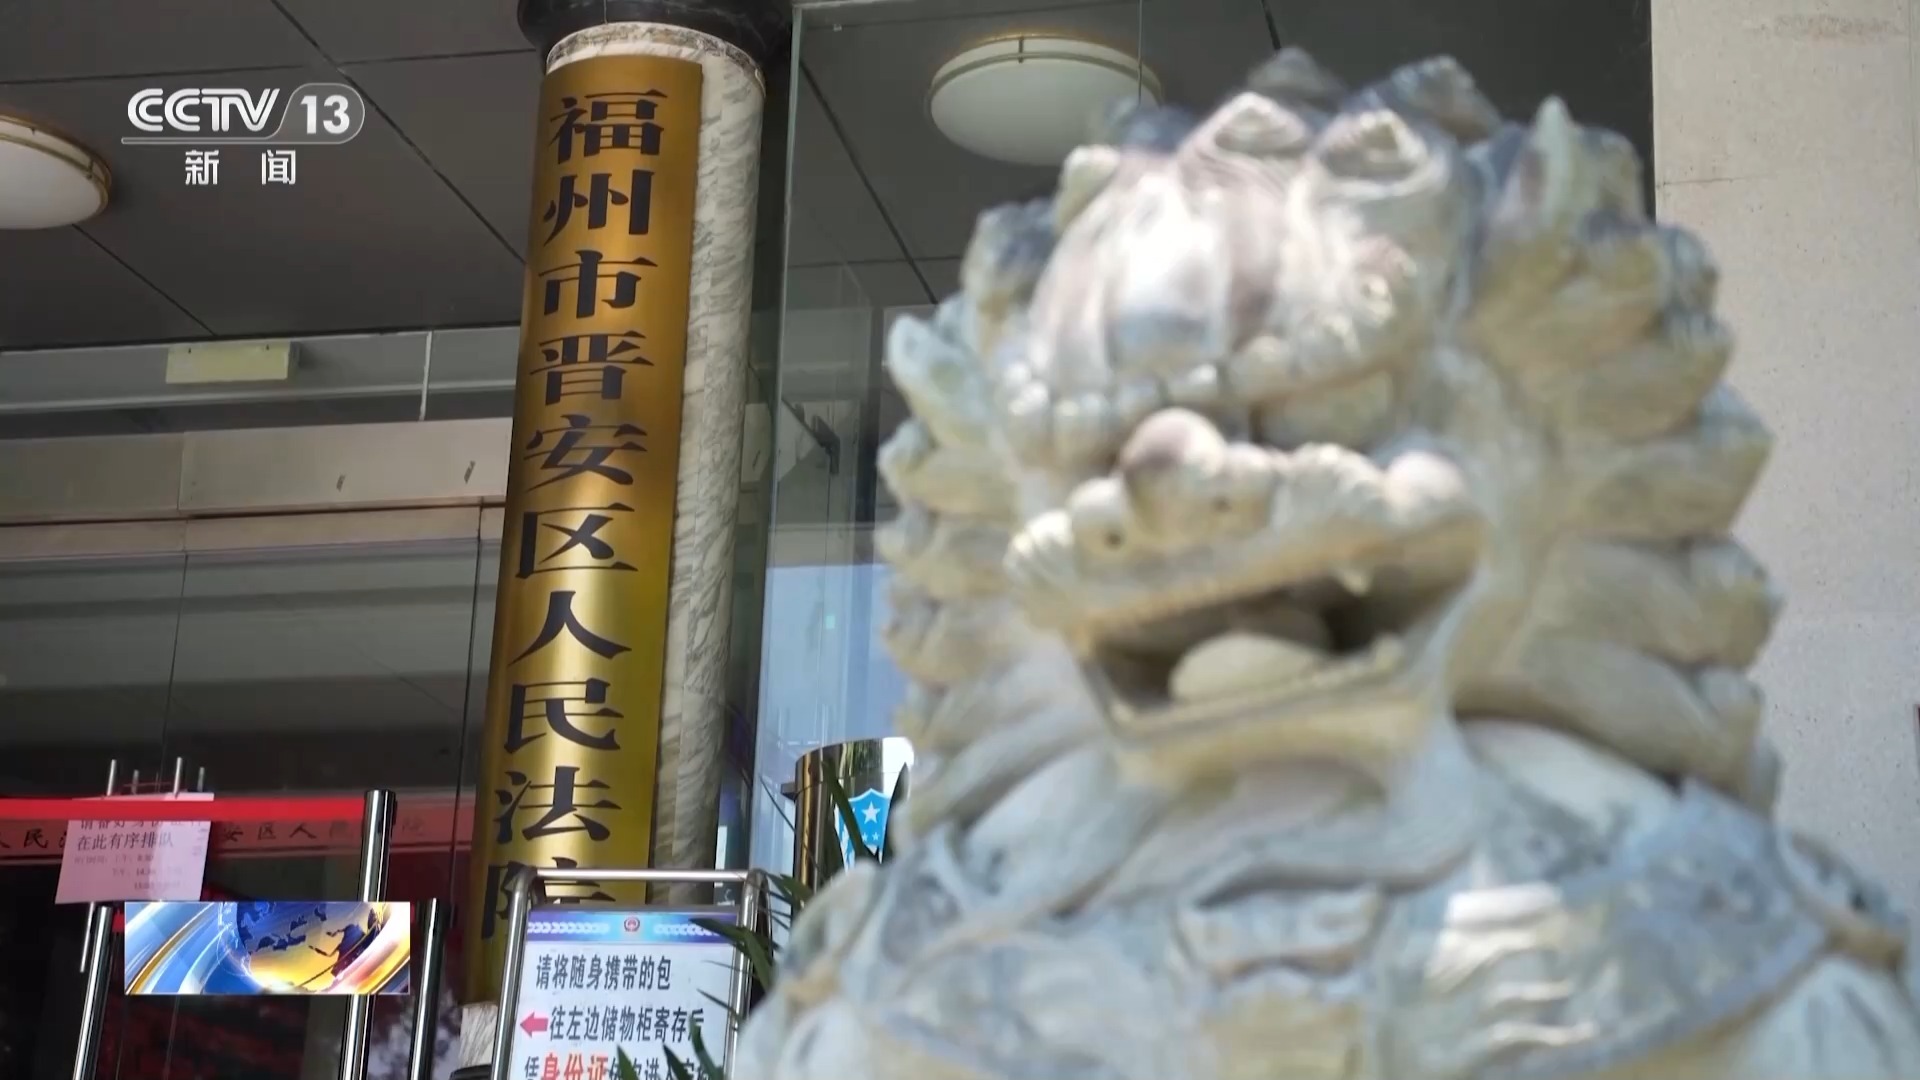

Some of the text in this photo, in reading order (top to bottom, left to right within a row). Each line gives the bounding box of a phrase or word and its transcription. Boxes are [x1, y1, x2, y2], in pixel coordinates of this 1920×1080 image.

[77, 831, 174, 851] 在此有序排队
[535, 953, 672, 991] 请将随身携带的包
